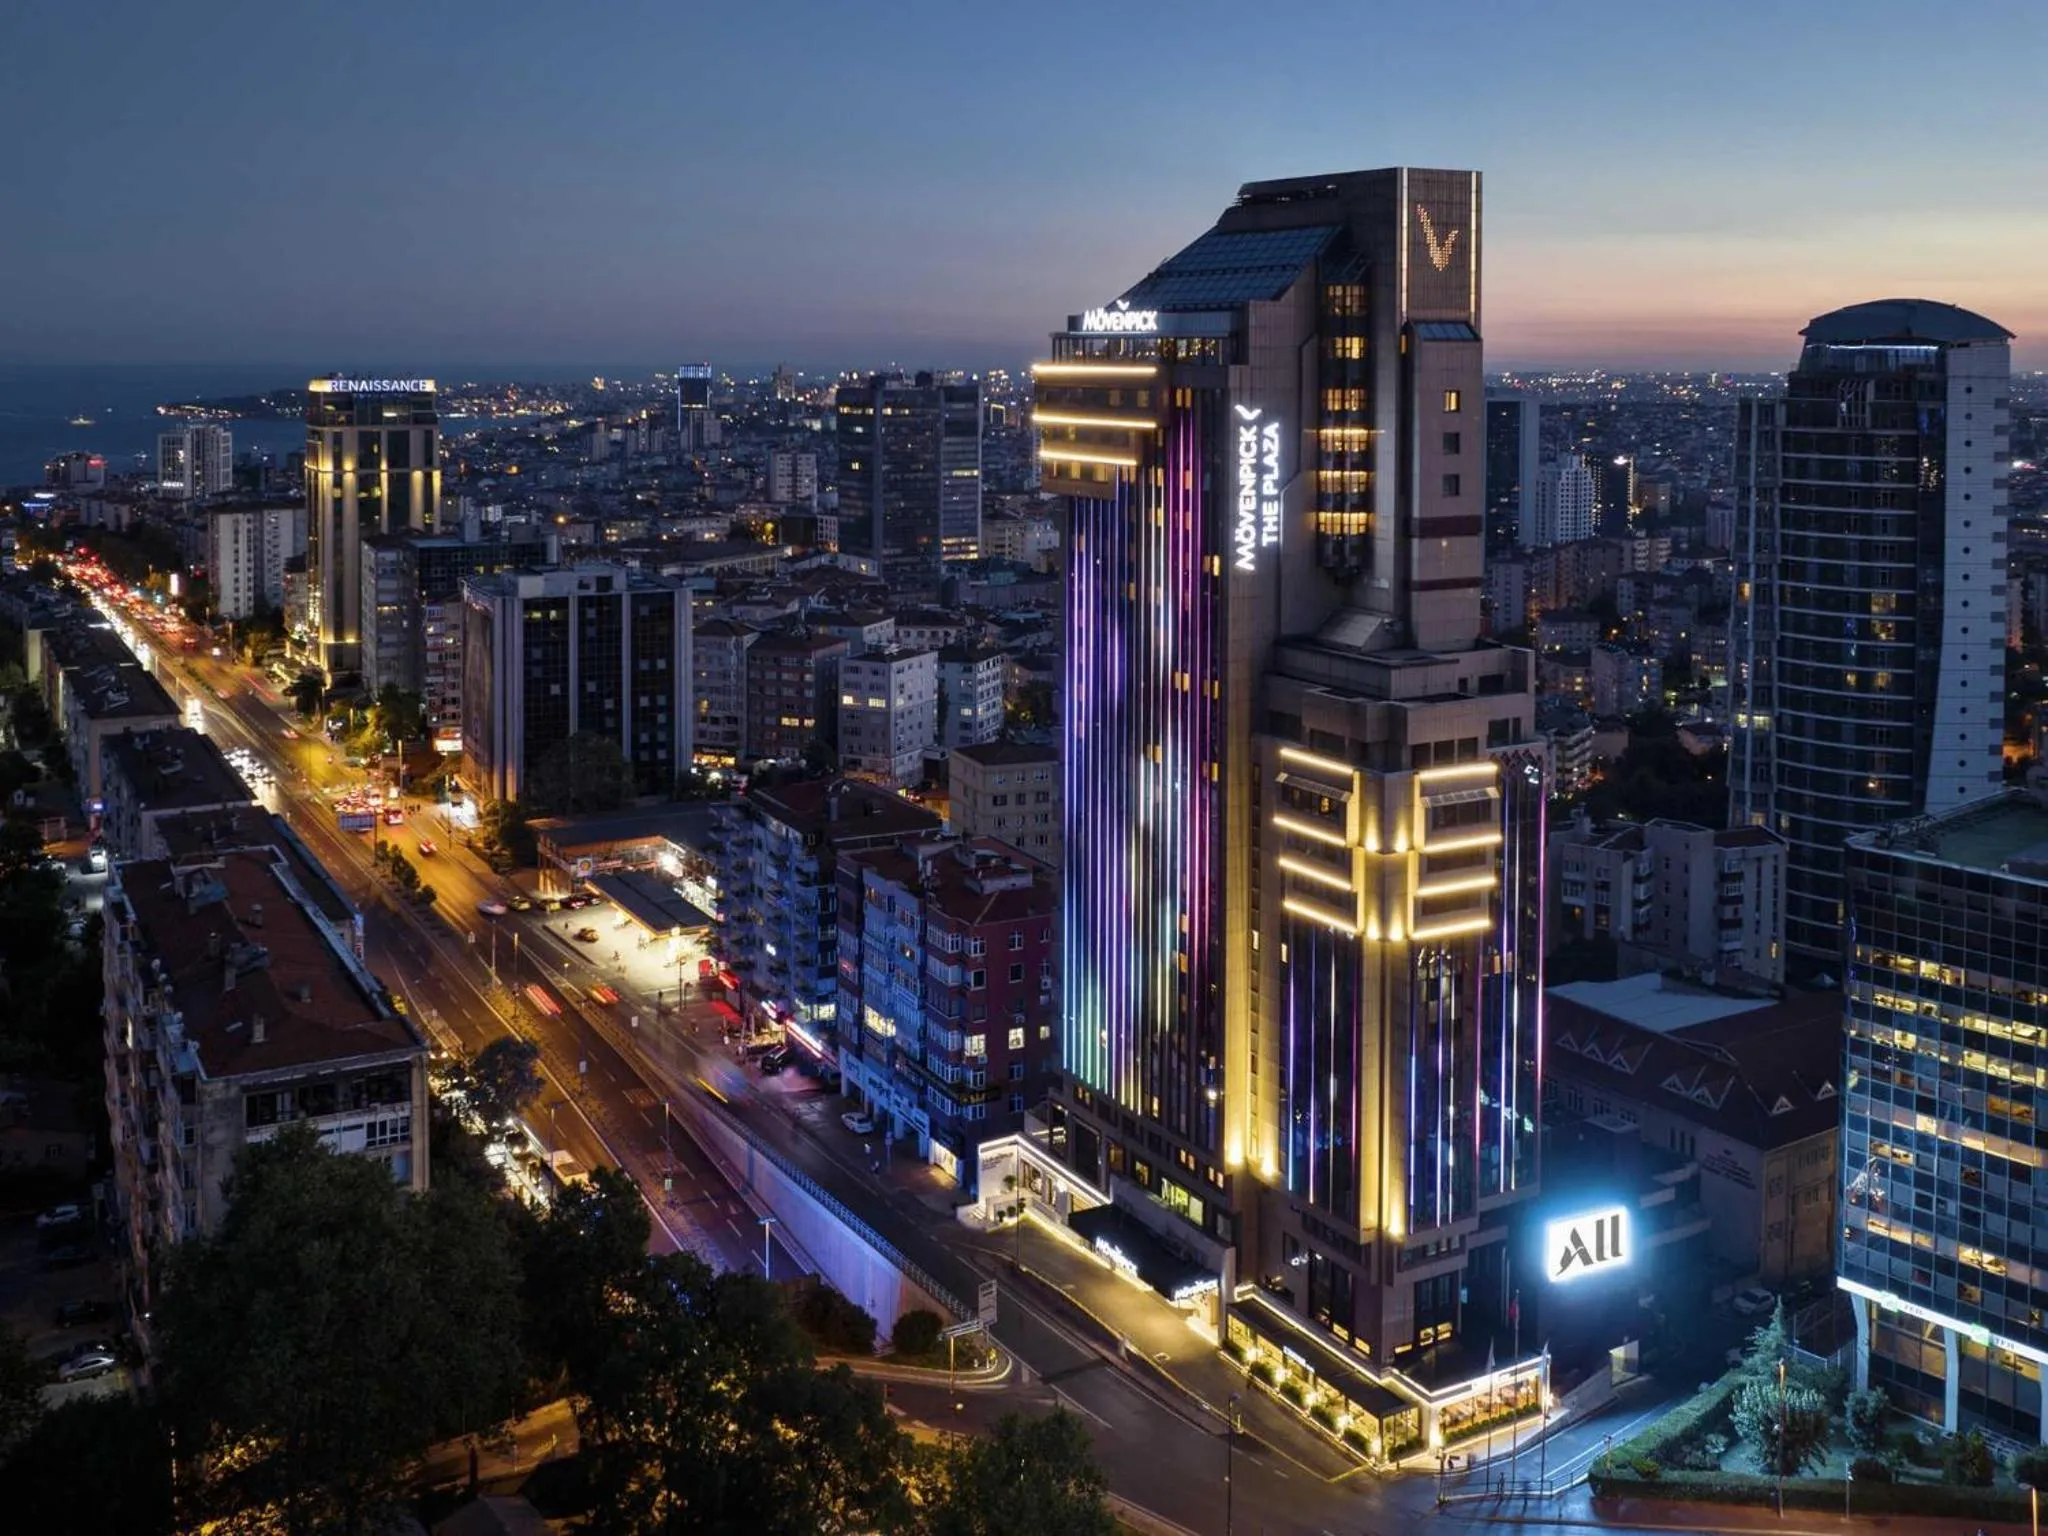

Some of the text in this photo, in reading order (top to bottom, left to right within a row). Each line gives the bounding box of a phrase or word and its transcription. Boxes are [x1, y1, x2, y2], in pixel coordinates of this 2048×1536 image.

[331, 379, 427, 392] RENAISSANCE
[1235, 425, 1257, 571] MÖVENPICK
[1262, 421, 1280, 547] THE PLAZA
